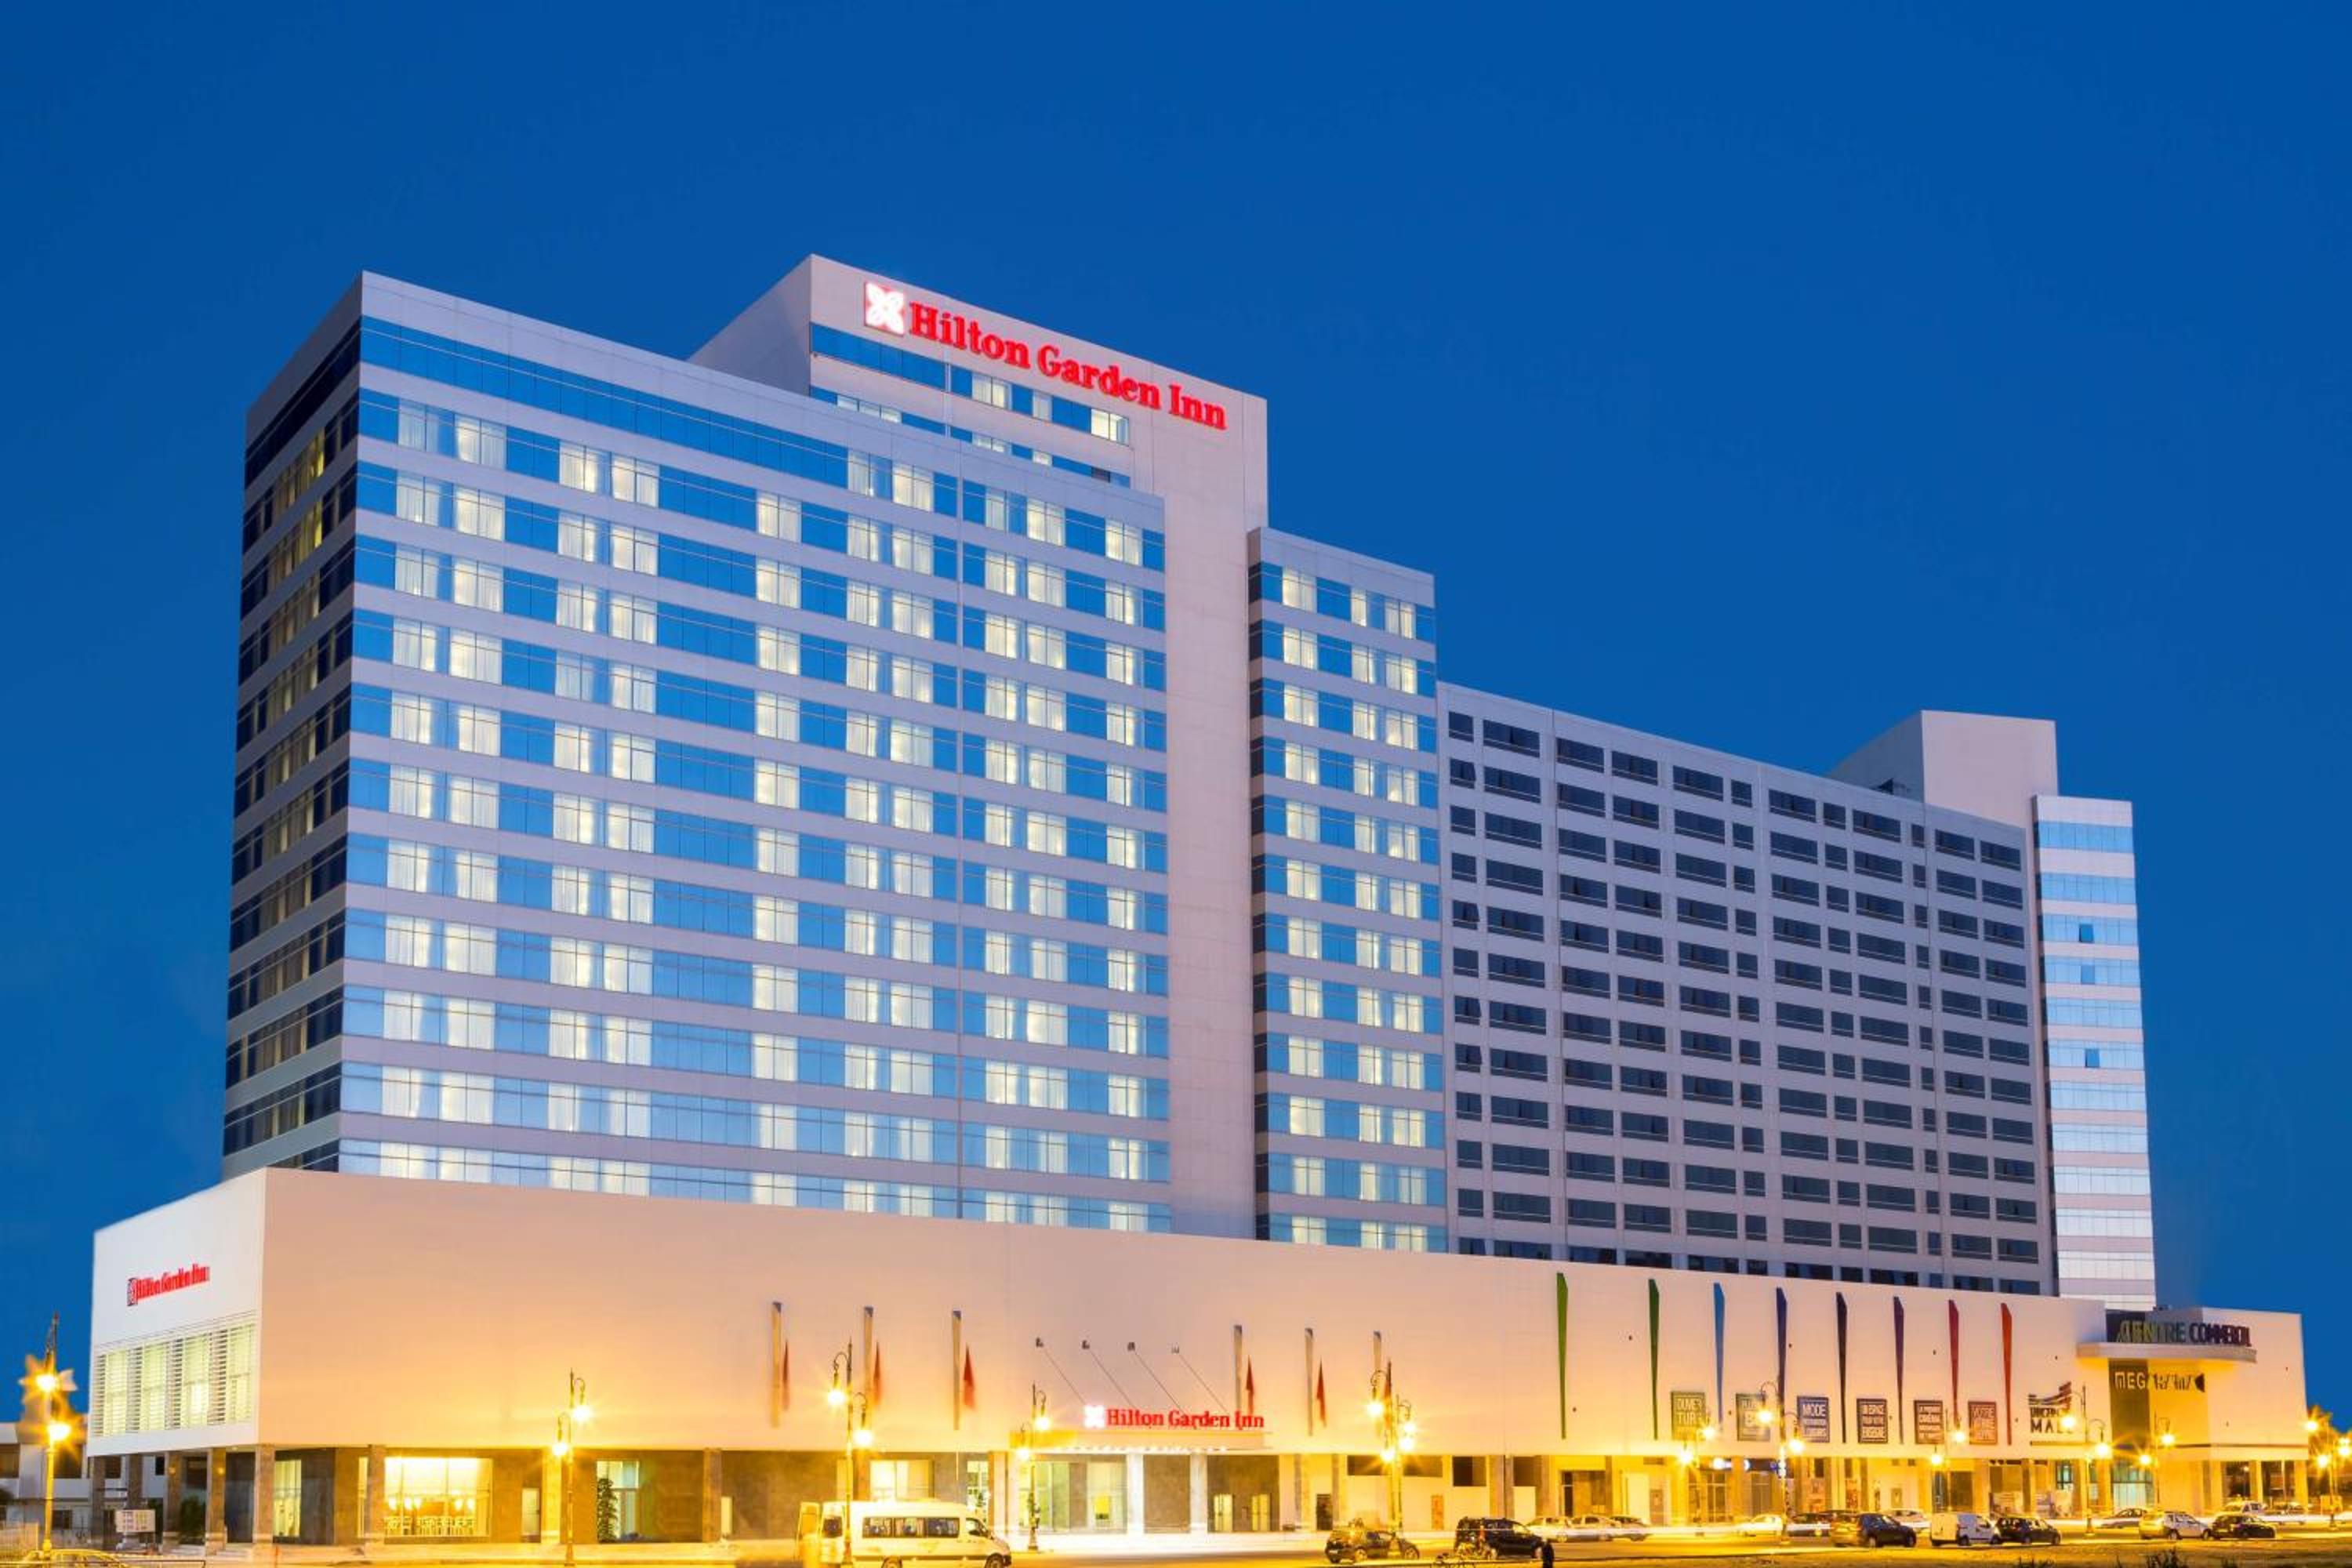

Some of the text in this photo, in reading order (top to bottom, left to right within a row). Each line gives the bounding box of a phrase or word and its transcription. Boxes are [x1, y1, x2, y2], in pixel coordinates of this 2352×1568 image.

[909, 301, 1227, 430] Hilton Garden Inn
[1106, 1409, 1264, 1428] Hilton Garden Inn
